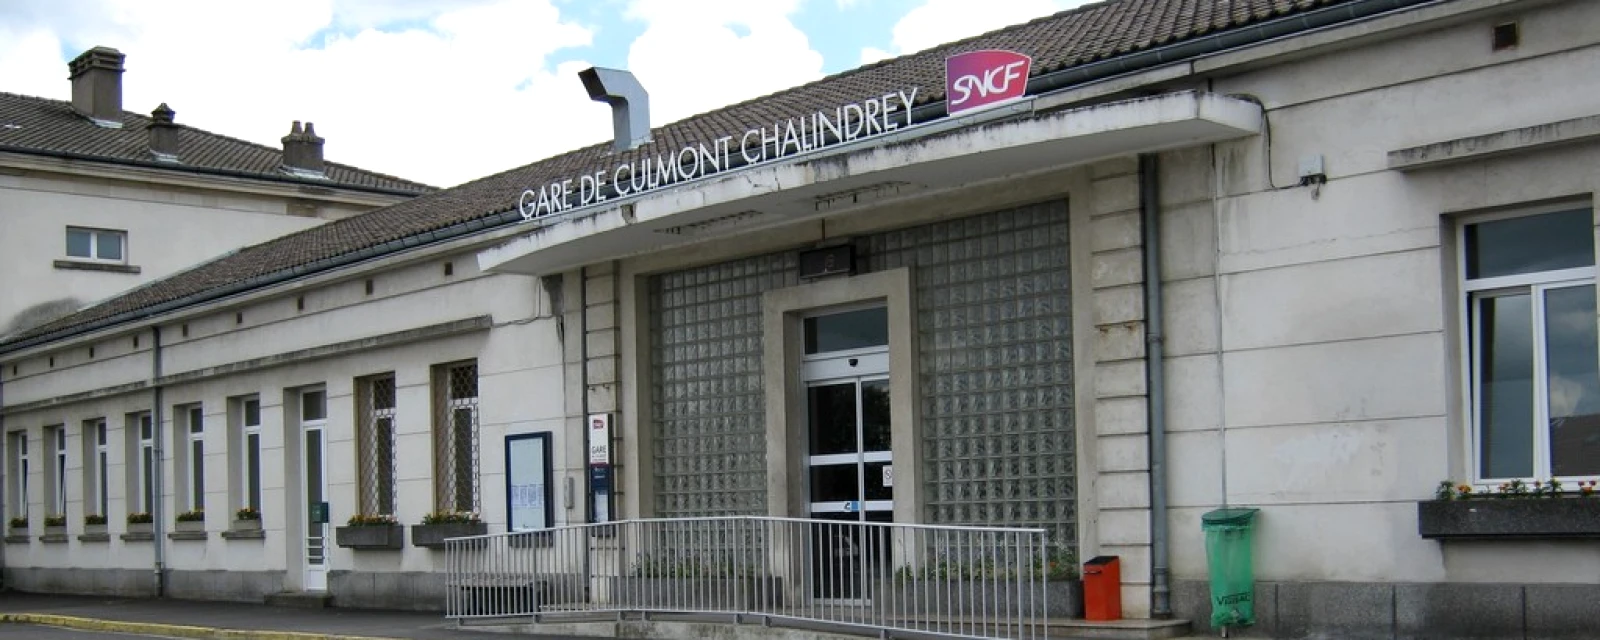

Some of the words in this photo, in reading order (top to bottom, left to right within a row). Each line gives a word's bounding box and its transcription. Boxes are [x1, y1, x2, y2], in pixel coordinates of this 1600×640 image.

[951, 61, 1025, 105] SNCF
[519, 179, 573, 219] GARE
[580, 170, 606, 206] DE
[613, 136, 732, 197] CULMONT
[741, 87, 918, 165] CHALINDREY
